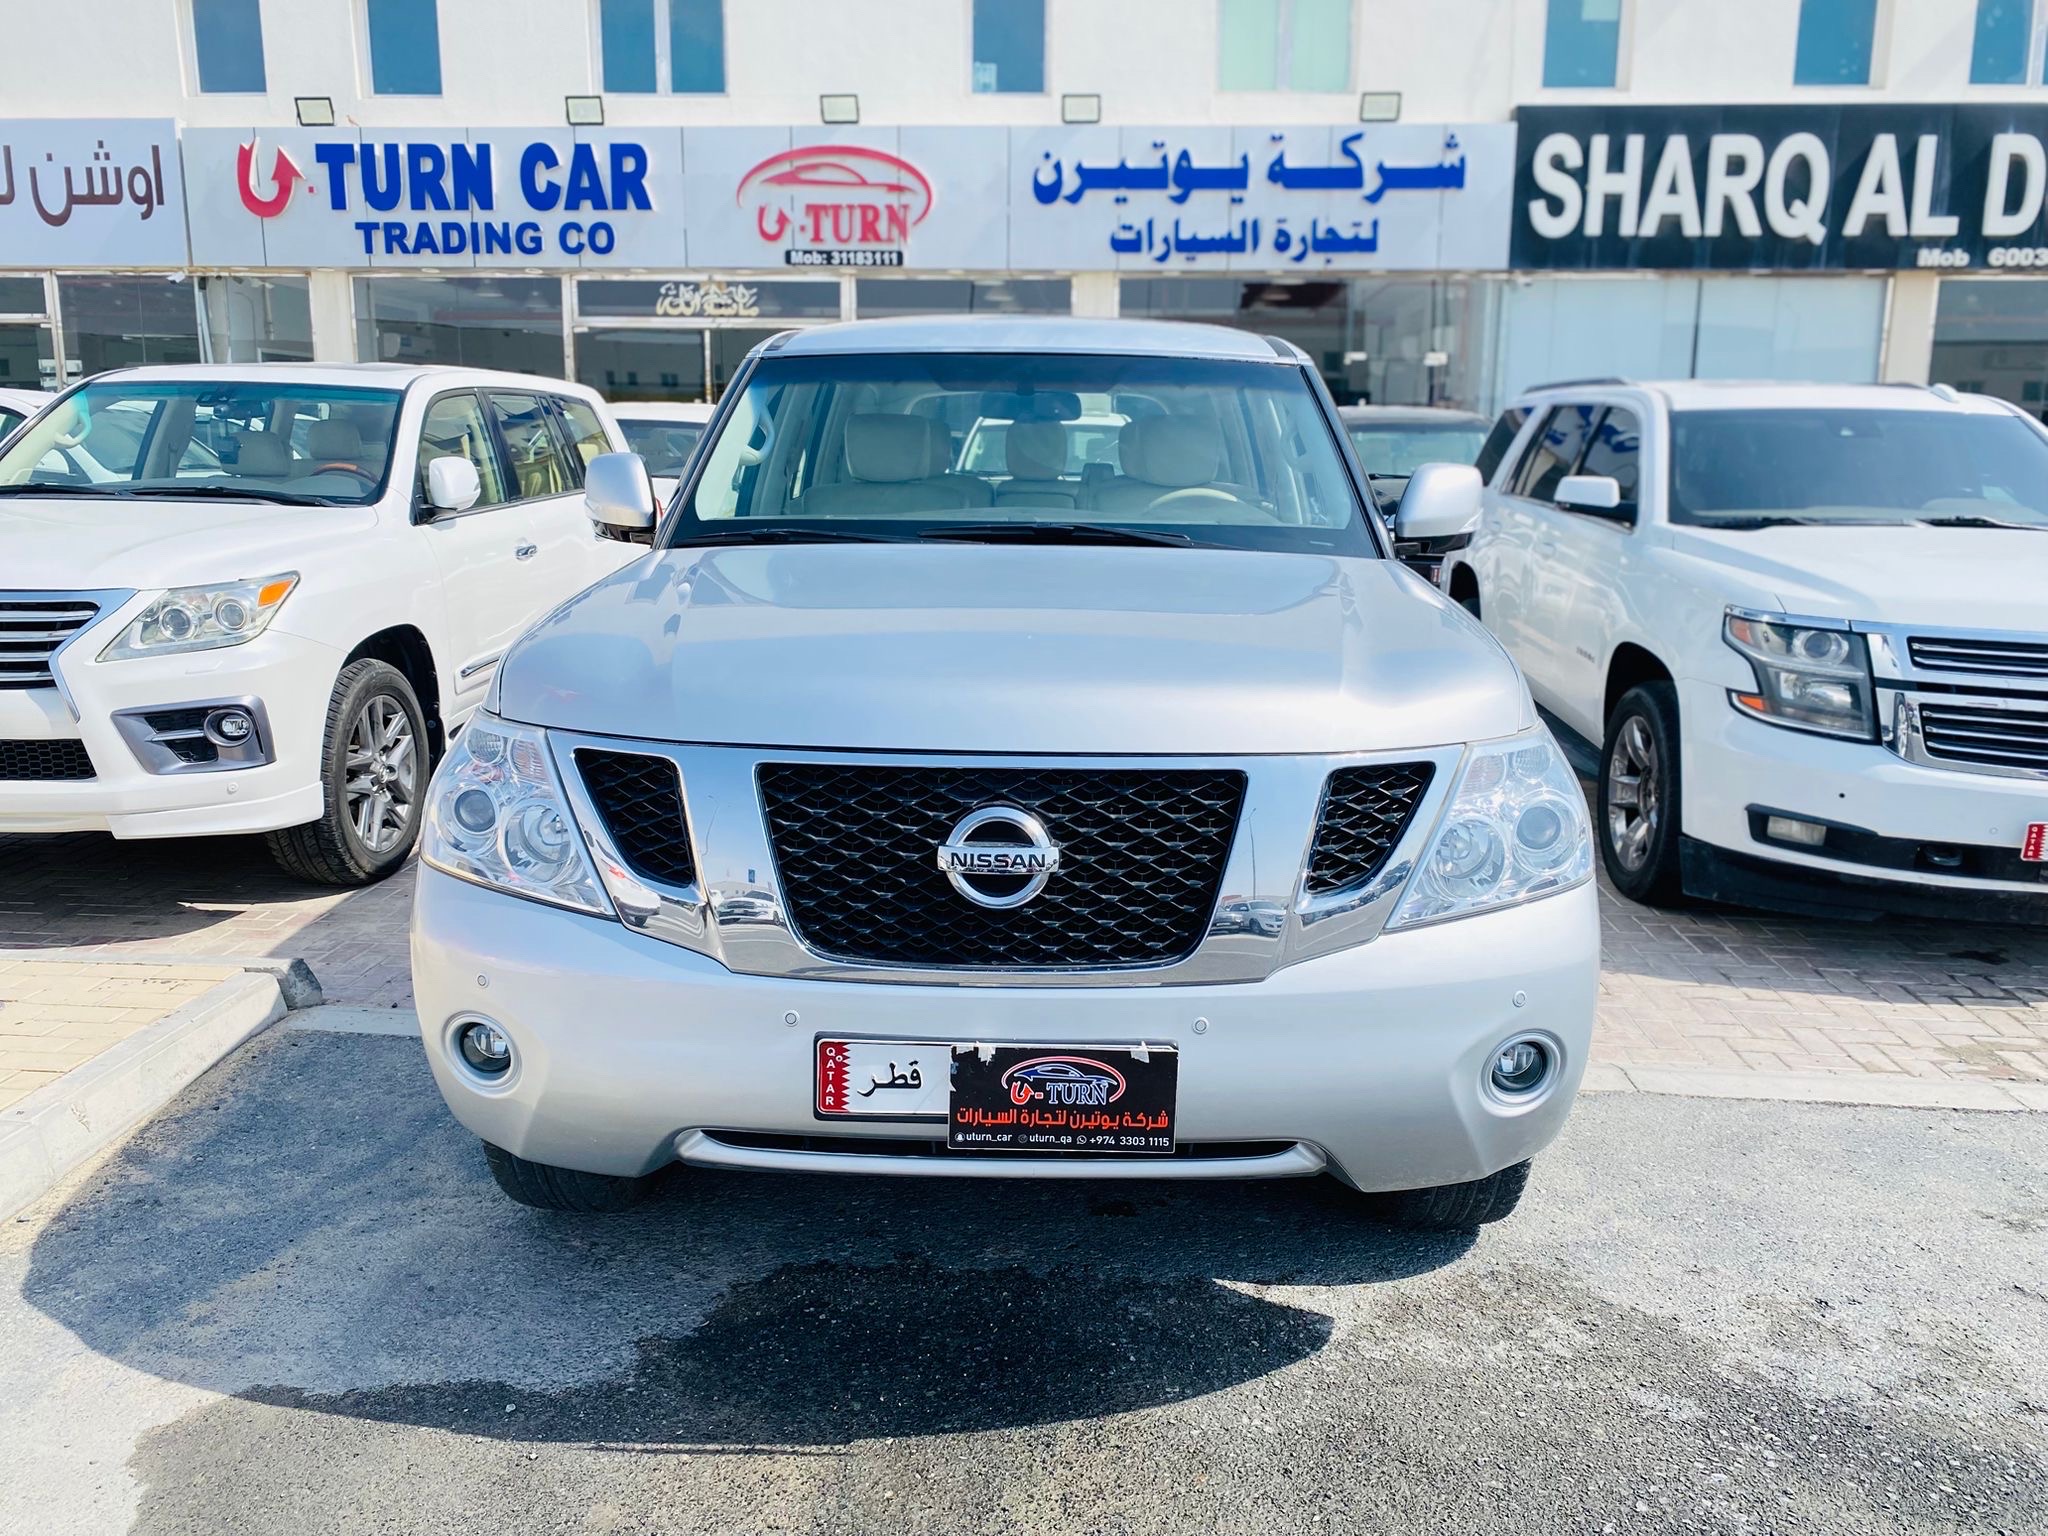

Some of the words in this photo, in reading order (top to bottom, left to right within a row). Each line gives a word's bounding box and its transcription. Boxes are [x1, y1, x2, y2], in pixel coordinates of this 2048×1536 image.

[520, 142, 654, 211] CAR
[1033, 141, 1250, 204] يوتيرن
[1267, 132, 1467, 203] شركة
[1528, 132, 1831, 246] SHARQ
[1842, 133, 1960, 238] AL
[1981, 132, 2048, 238] D
[355, 222, 544, 255] TRADING
[559, 221, 616, 255] CO
[1110, 217, 1260, 263] السيارات
[1273, 217, 1379, 264] لتجارة
[790, 250, 828, 265] Mob:
[1916, 248, 1971, 268] Mob
[2027, 826, 2039, 857] QATAR
[950, 852, 1046, 869] NISSAN
[825, 1047, 836, 1106] QATAR
[856, 1060, 922, 1098] قطر
[956, 1107, 1017, 1128] السيارات
[1020, 1108, 1067, 1128] لتجارة
[1069, 1110, 1120, 1130] يوتيرن
[1122, 1110, 1169, 1131] شركة
[966, 1132, 1013, 1143] uturn_car
[1029, 1133, 1073, 1144] uturn_qa
[1089, 1135, 1116, 1146] +974
[1119, 1136, 1146, 1147] 3303
[1148, 1136, 1170, 1147] 1115
